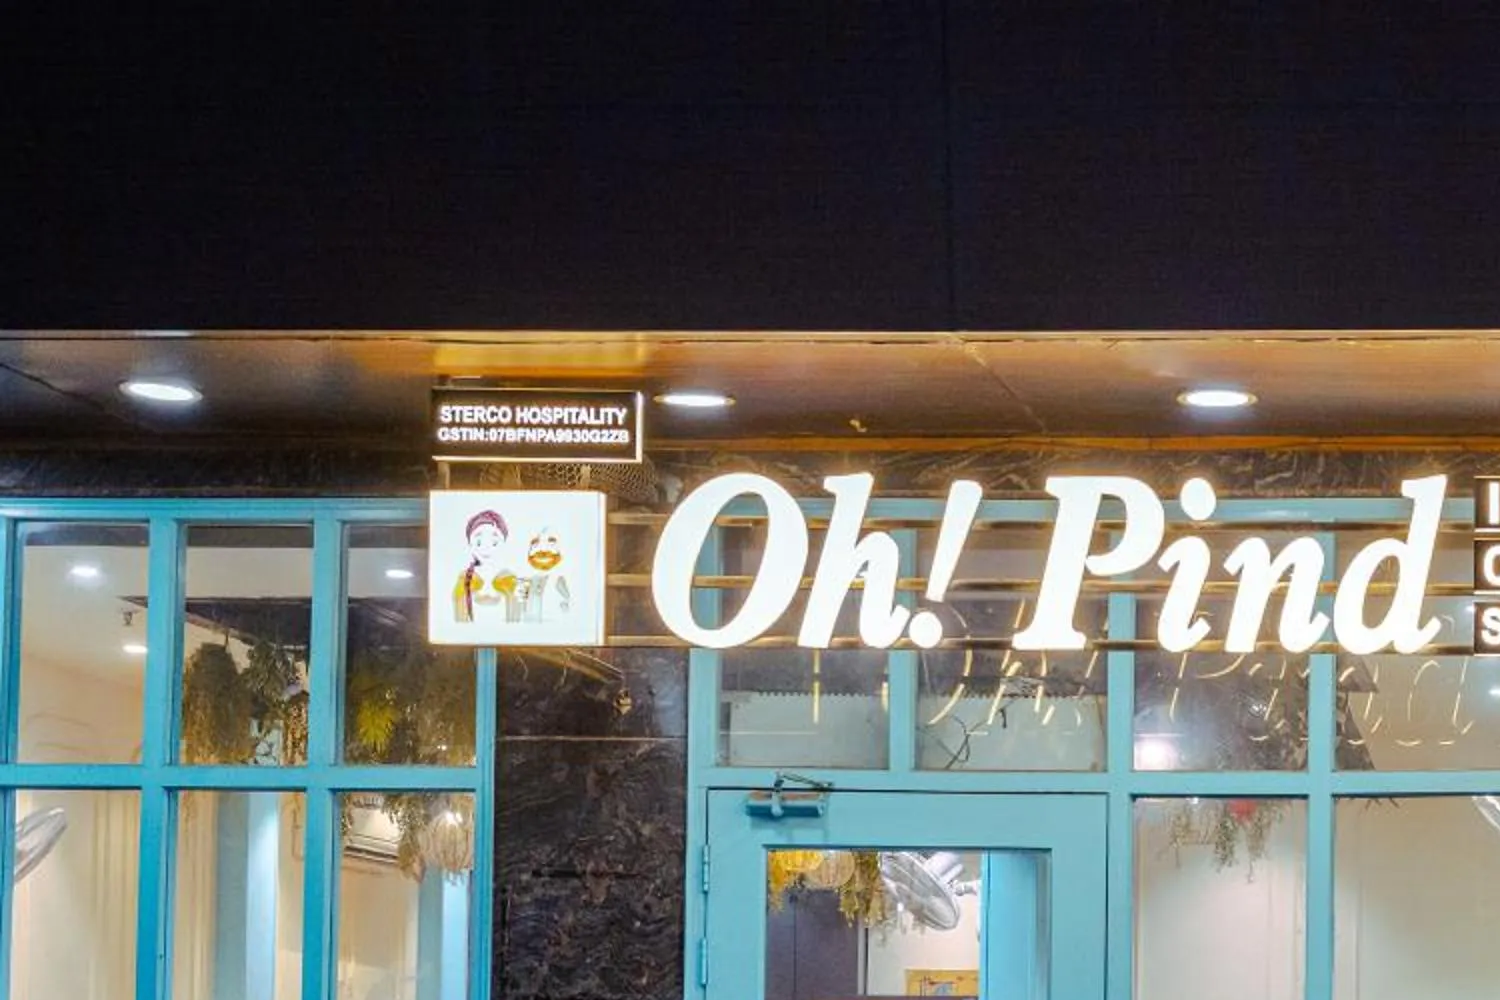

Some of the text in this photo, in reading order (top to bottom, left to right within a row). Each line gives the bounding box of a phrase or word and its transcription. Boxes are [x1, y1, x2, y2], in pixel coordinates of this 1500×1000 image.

[440, 406, 628, 425] STERCO HOSPITALITY
[651, 471, 1449, 655] Oh! Pind
